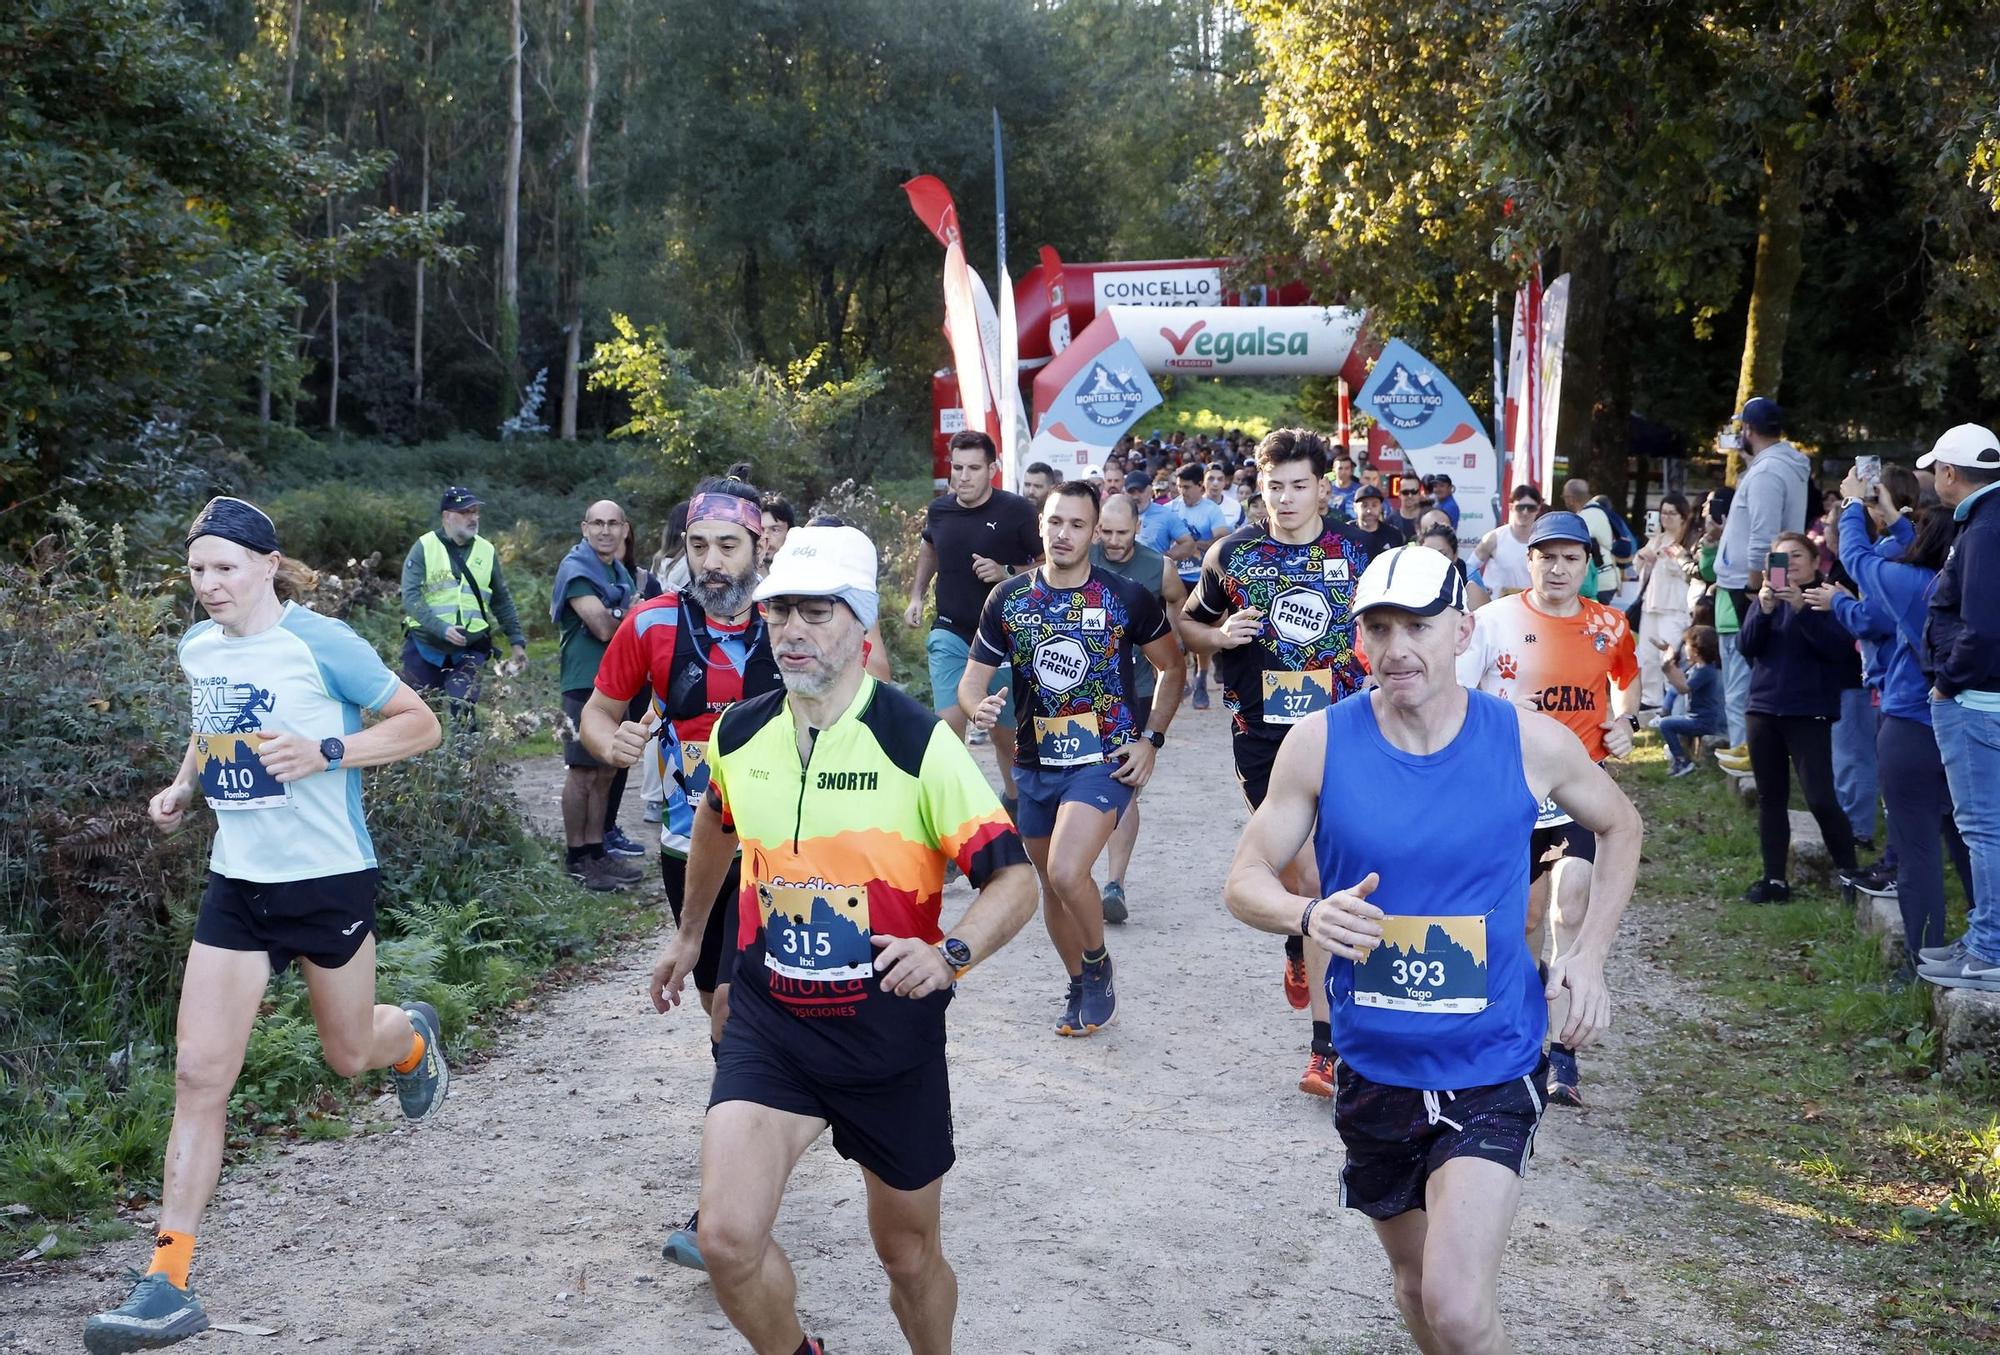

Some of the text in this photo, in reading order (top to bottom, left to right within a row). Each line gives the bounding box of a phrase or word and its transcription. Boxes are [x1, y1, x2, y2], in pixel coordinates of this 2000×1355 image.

[1104, 280, 1210, 298] CONCELLO
[1160, 320, 1308, 363] Vegalsa
[1076, 393, 1141, 404] MONTES DE VIGO
[1374, 395, 1441, 405] MONTES DE VIGO
[1096, 416, 1123, 425] TRAIL
[1392, 417, 1420, 428] TRAIL
[1326, 569, 1343, 578] AXA
[1281, 600, 1324, 622] PONLE
[1084, 618, 1101, 628] AXA
[1278, 612, 1319, 632] FRENO
[1042, 650, 1083, 668] PONLE
[1039, 659, 1078, 680] FRENO
[1283, 695, 1312, 710] 377
[1053, 738, 1080, 753] 379
[217, 768, 254, 788] 410
[817, 772, 878, 791] 3NORTH
[224, 789, 250, 799] Pombo
[782, 929, 831, 956] 315
[1392, 959, 1445, 987] 393
[1405, 987, 1433, 1001] Yago
